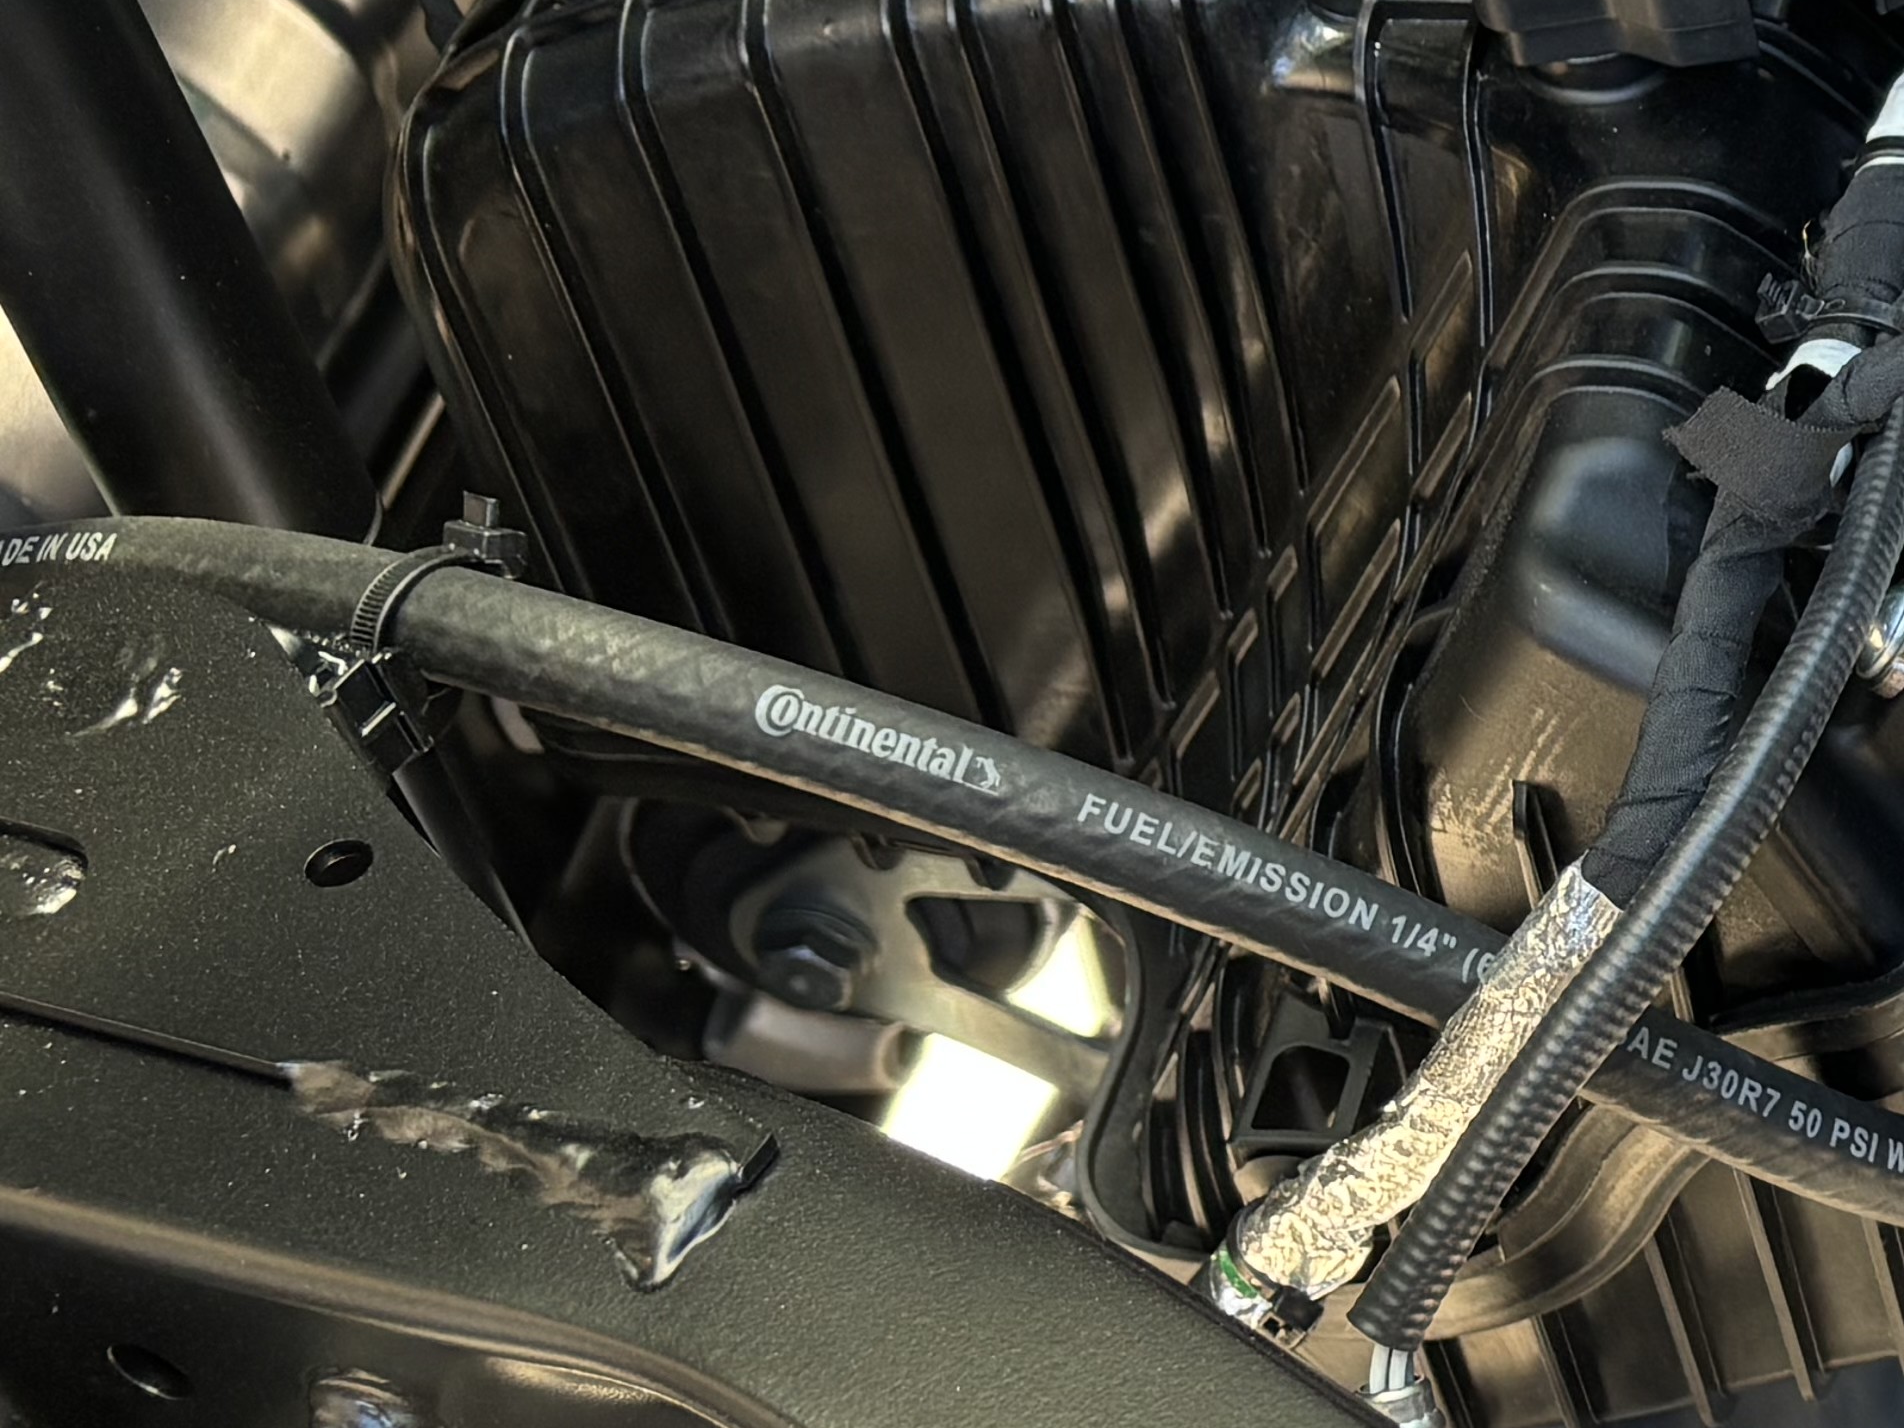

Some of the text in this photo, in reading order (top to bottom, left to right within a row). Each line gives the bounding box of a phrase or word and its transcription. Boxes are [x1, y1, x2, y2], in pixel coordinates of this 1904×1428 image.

[0, 531, 118, 567] DE IN USA
[754, 684, 975, 784] Continental
[1076, 792, 1379, 932] FUEL/EMISSION
[1390, 913, 1457, 958] 1/4"
[1626, 1025, 1679, 1070] AE
[1681, 1054, 1782, 1119] J30R7
[1787, 1099, 1823, 1139] 50
[1828, 1117, 1879, 1164] PSI
